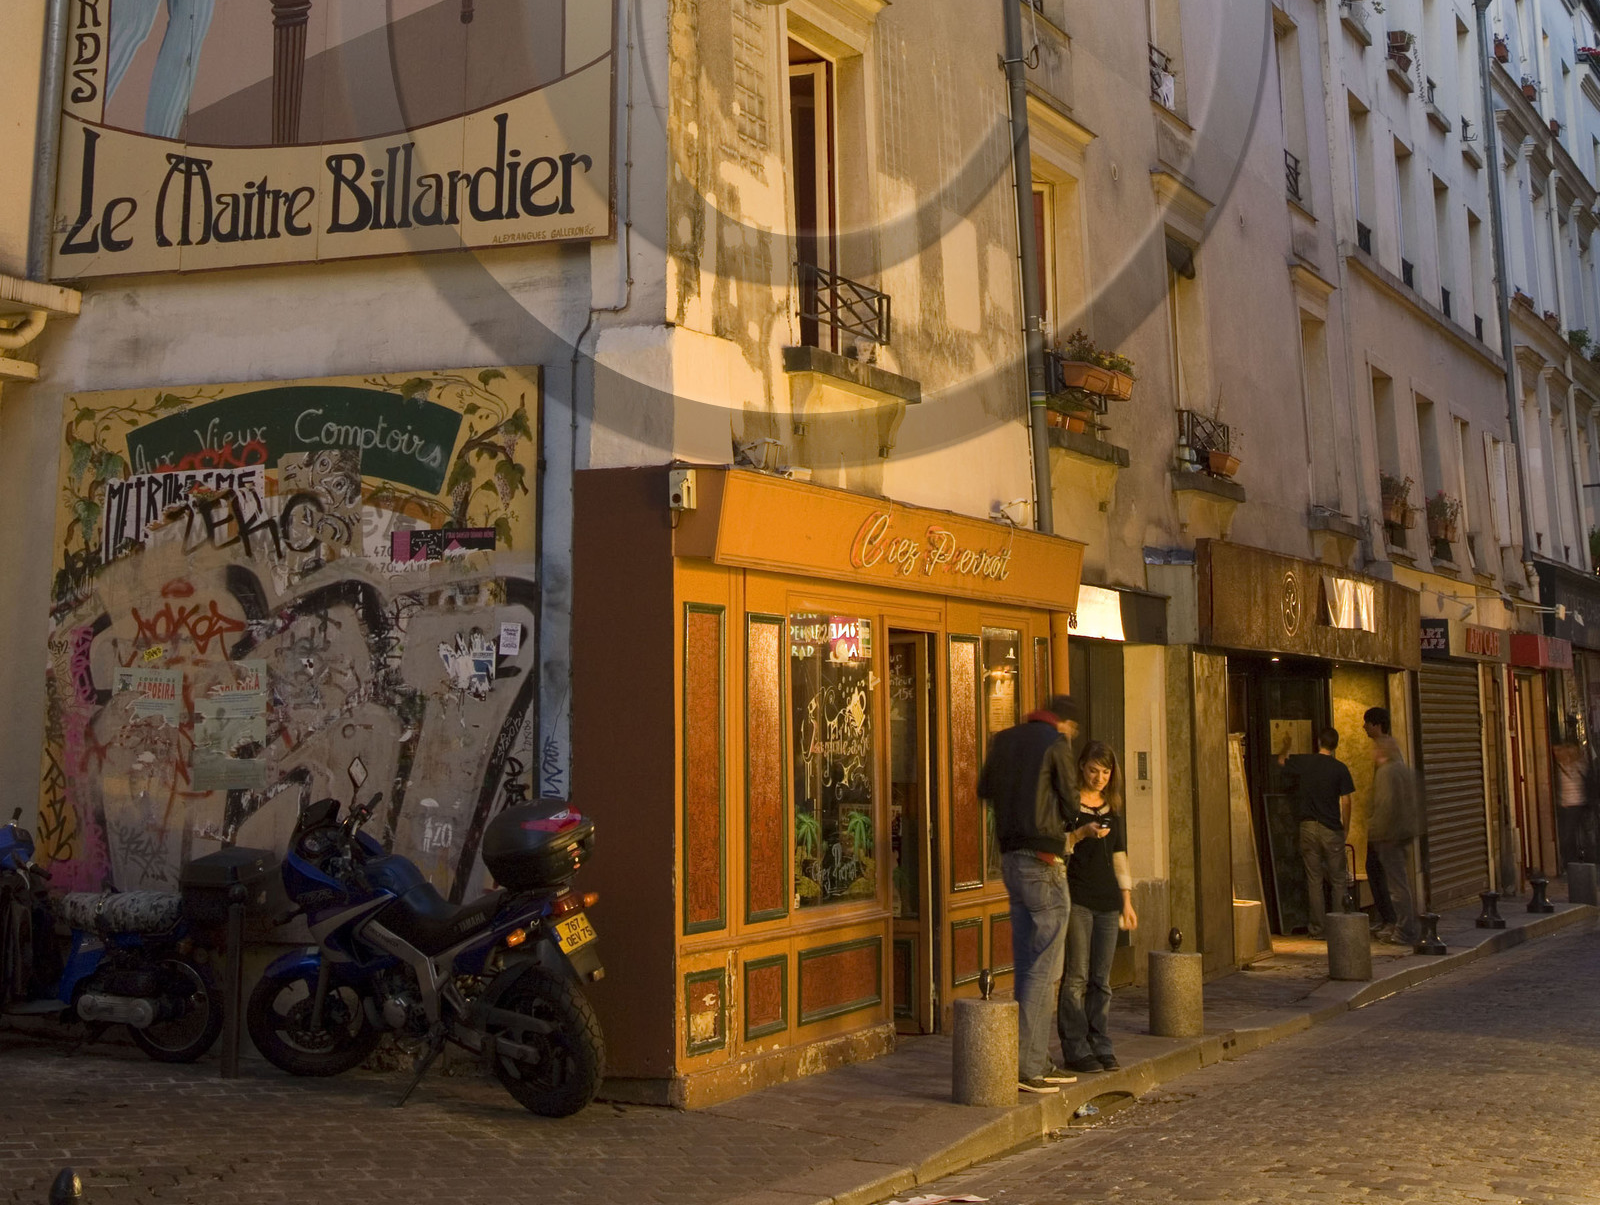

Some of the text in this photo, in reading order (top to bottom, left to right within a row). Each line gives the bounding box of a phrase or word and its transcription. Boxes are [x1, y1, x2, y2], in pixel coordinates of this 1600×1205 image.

[59, 113, 593, 256] Le Maitre Billardier
[134, 408, 442, 475] Aux Vieux Comptoirs
[565, 918, 581, 934] 767
[581, 927, 593, 939] 75
